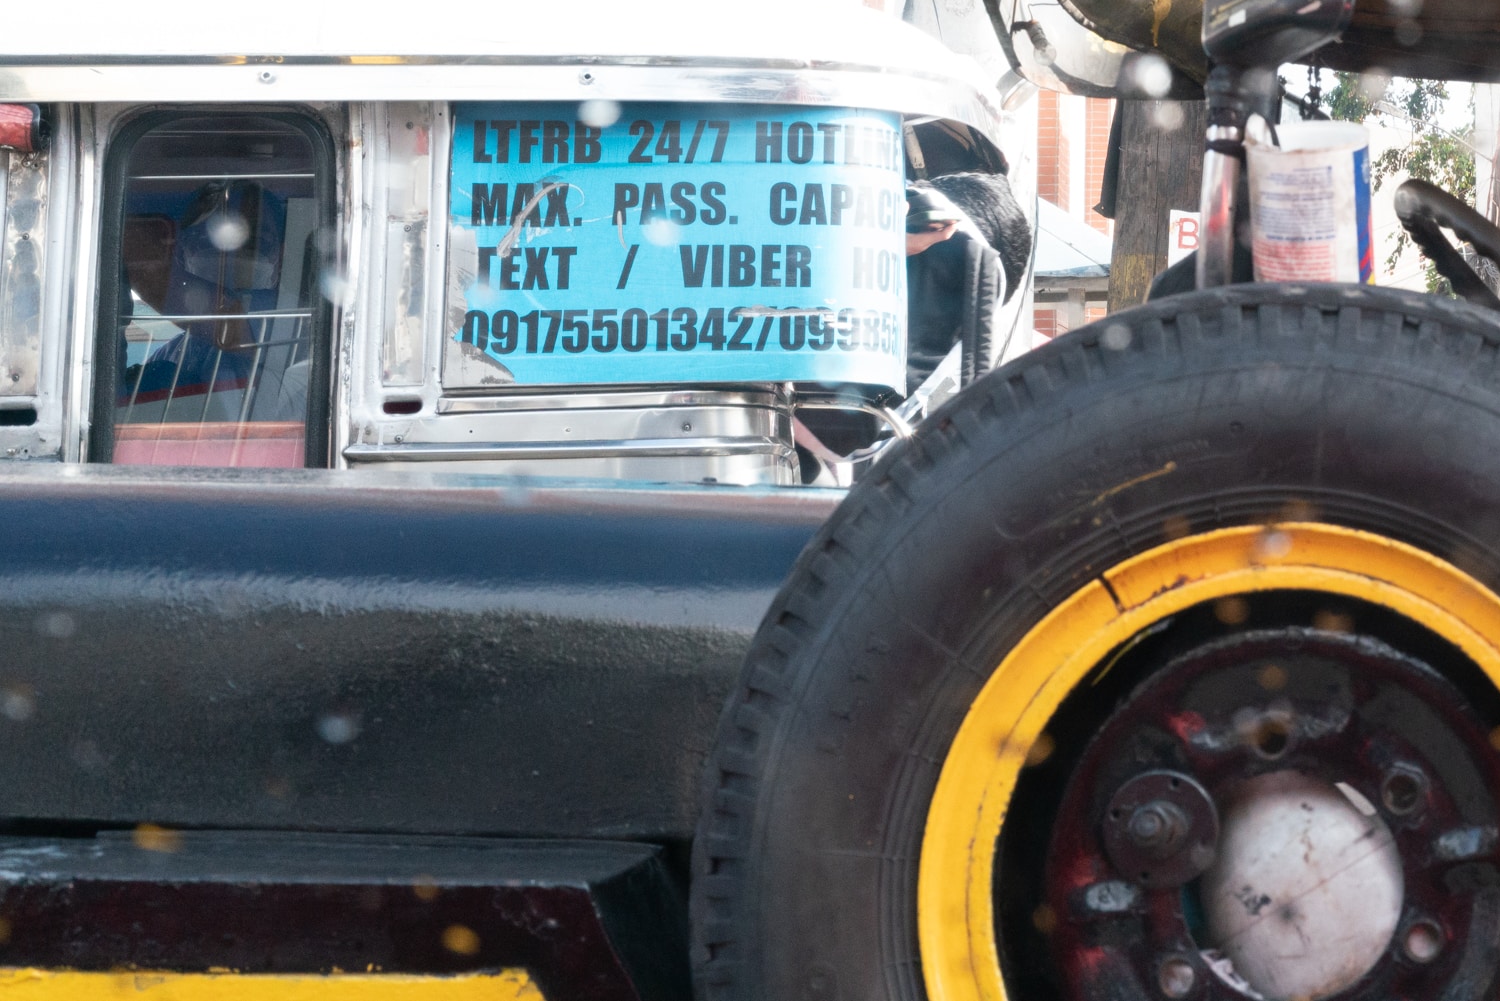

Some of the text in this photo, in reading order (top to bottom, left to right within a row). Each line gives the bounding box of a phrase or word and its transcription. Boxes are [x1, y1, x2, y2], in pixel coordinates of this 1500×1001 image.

[472, 119, 602, 164] LTFRB
[627, 119, 731, 164] 24/7
[470, 181, 583, 228] MAX.
[611, 181, 739, 227] PASS.
[477, 246, 578, 291] TEXT
[678, 243, 813, 289] VIBER
